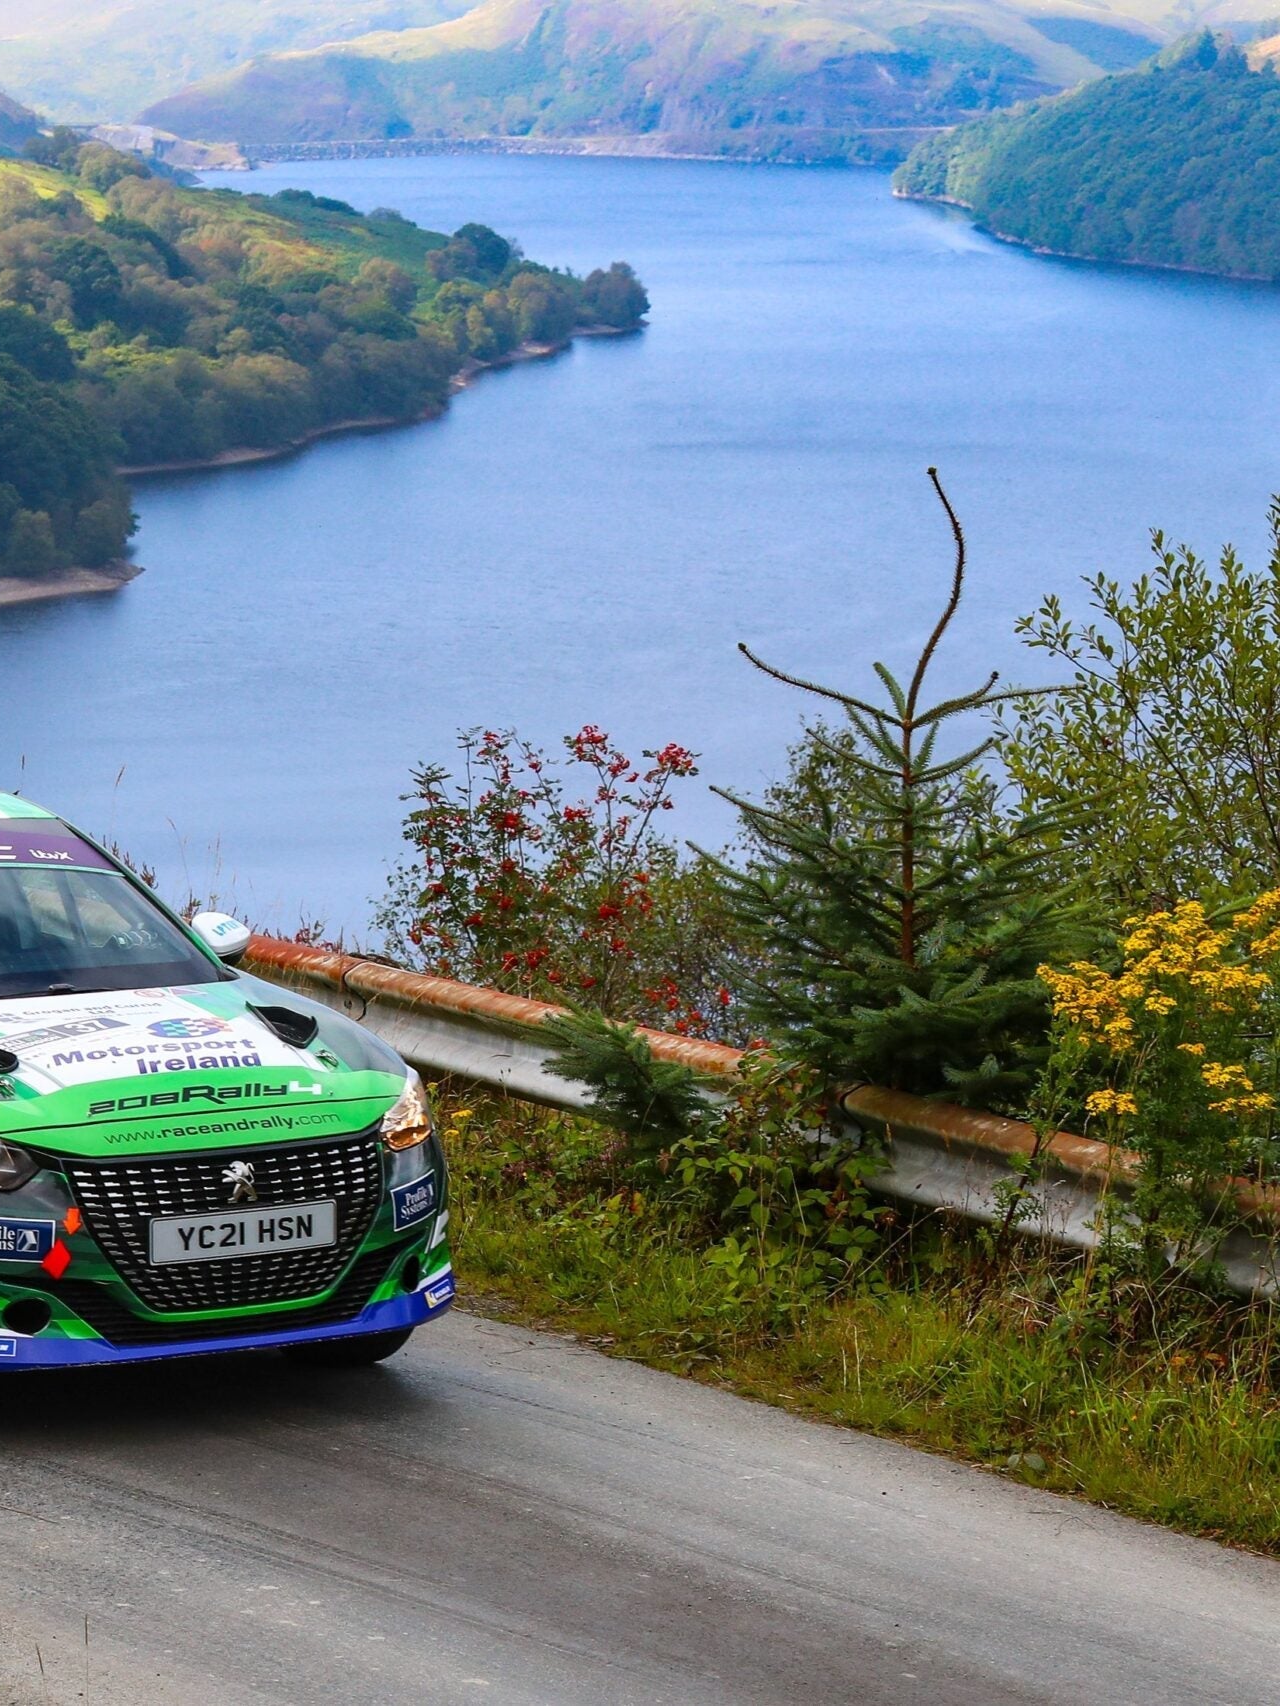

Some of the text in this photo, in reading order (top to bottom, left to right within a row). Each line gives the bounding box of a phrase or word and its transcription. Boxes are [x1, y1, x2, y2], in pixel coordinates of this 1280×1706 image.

[64, 1020, 108, 1032] 37
[52, 1038, 256, 1067] Motorsport
[136, 1053, 261, 1074] Ireland
[104, 1113, 342, 1144] www.raceandrally.com
[405, 1185, 428, 1207] Profile
[178, 1214, 312, 1251] YC21 HSN
